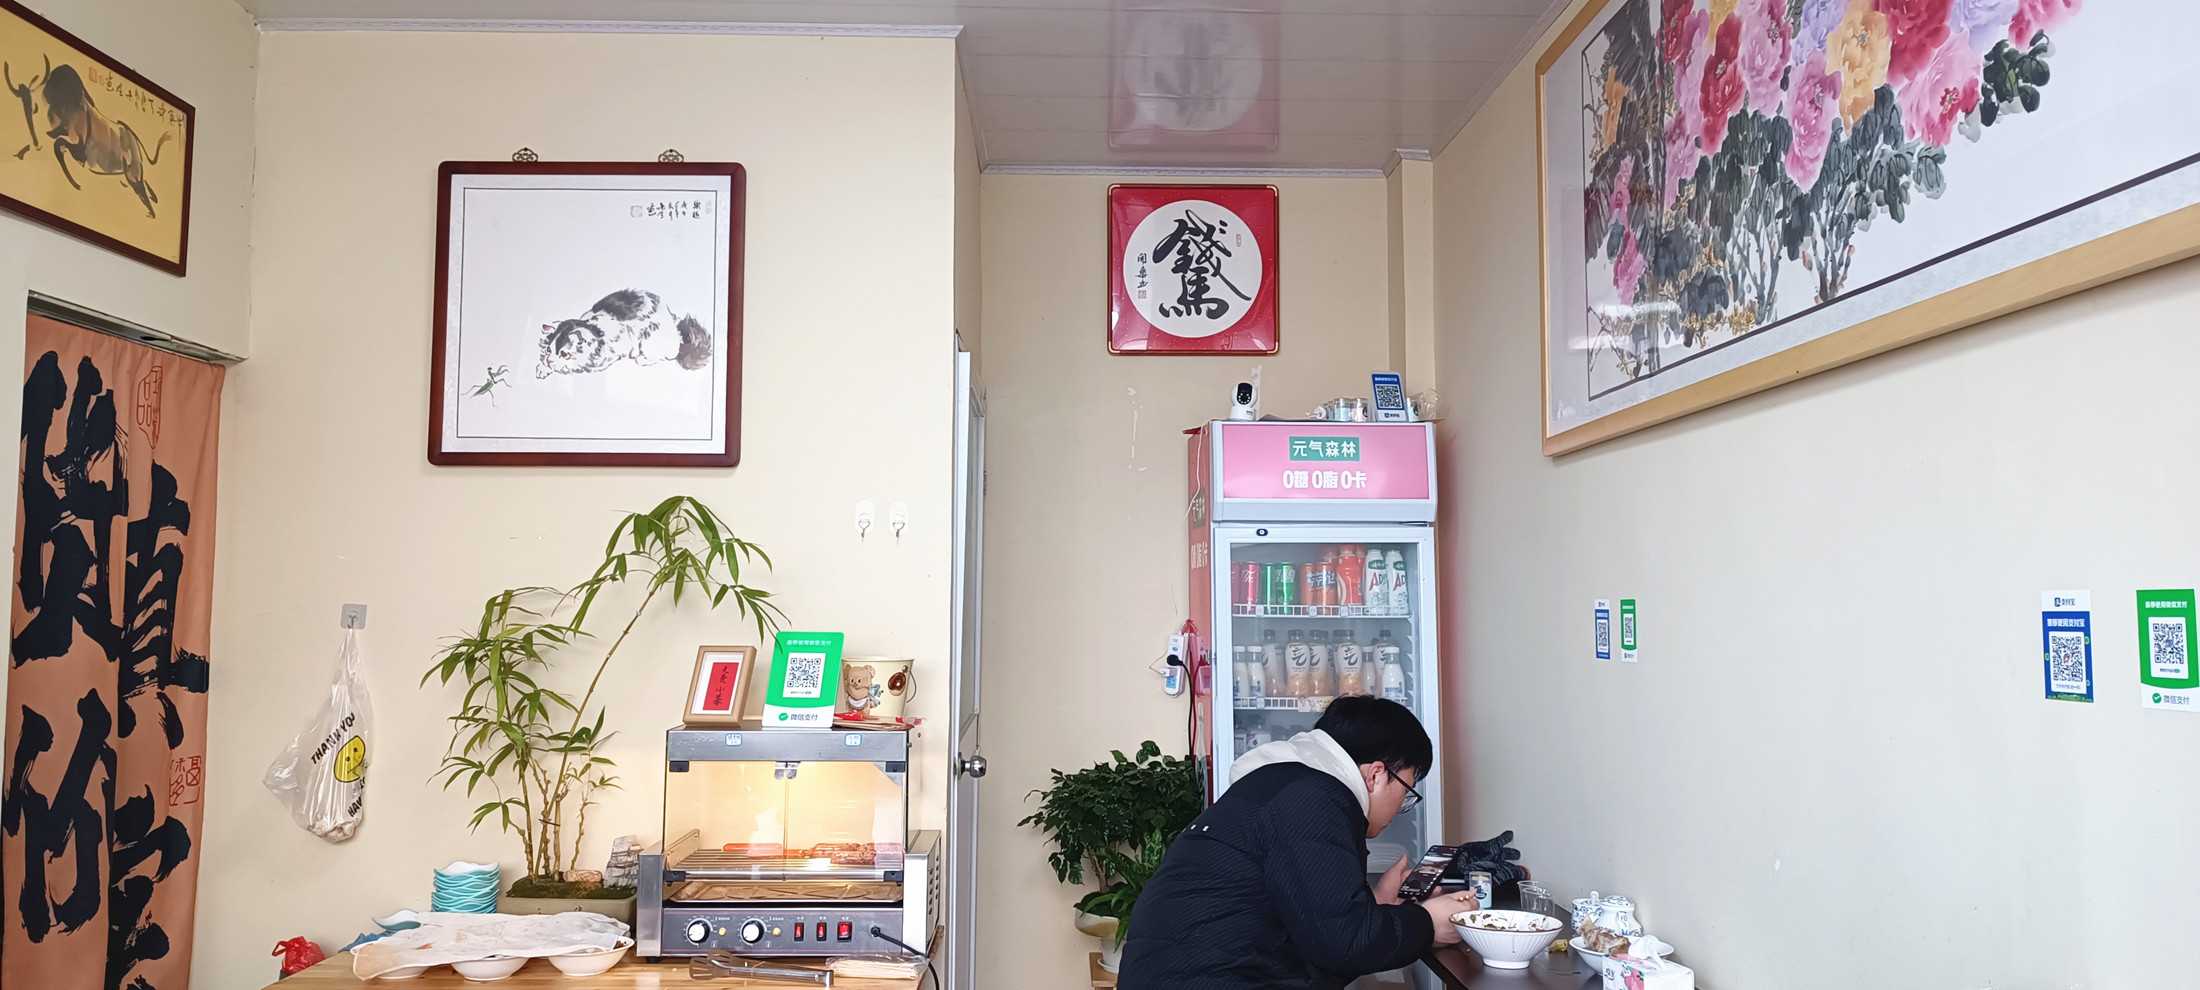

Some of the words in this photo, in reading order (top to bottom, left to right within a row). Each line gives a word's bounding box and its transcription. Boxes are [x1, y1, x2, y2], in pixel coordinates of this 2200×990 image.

[1292, 439, 1356, 458] 元气森林
[1282, 470, 1309, 489] 0糖
[1311, 470, 1339, 489] 0脂
[1340, 470, 1367, 489] 0卡
[2061, 598, 2076, 606] 支付宝
[2163, 695, 2190, 705] 微信支付
[790, 713, 818, 721] 微信支付
[347, 796, 363, 817] HAV
